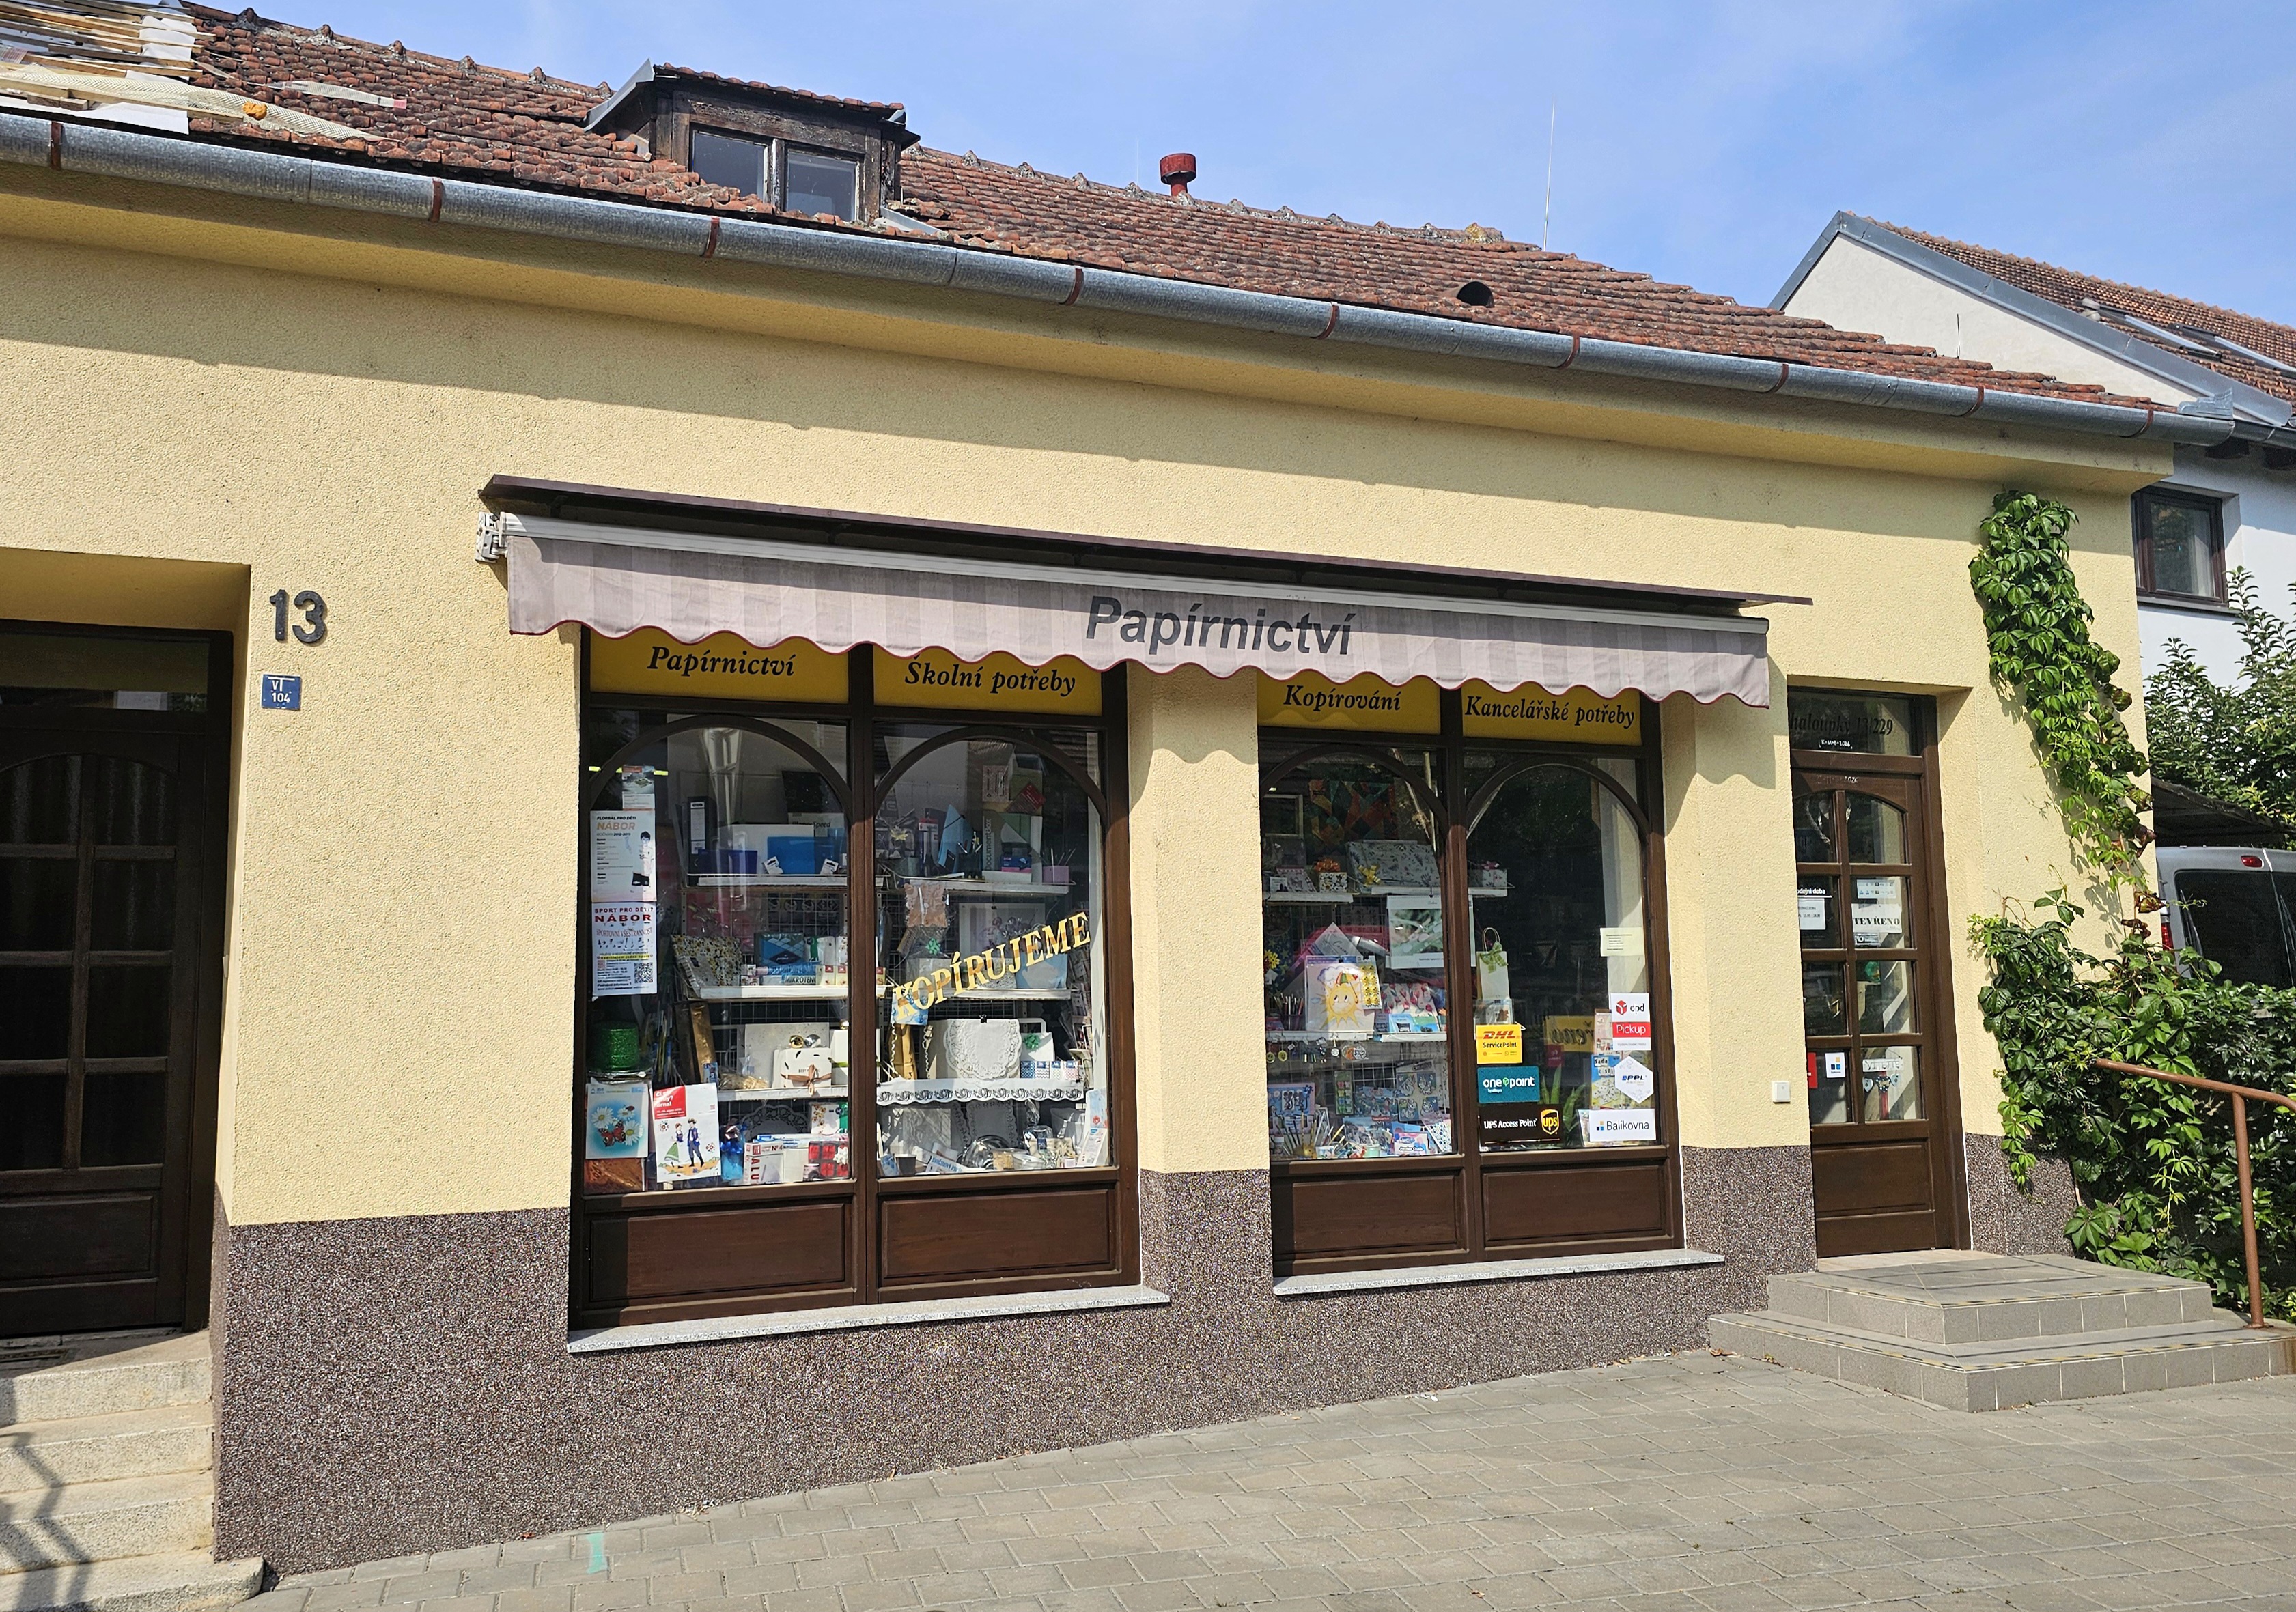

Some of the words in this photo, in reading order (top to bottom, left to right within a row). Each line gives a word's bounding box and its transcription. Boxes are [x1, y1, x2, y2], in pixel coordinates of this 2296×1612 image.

[270, 589, 326, 643] 13
[1086, 596, 1356, 655] Papírnictví
[647, 646, 796, 677] Papírnictví
[905, 655, 984, 688] Školní
[990, 666, 1076, 697] potřeby
[272, 692, 291, 703] 104
[1283, 685, 1402, 712] Kopírování
[1464, 695, 1569, 721] Kancelářské
[1574, 704, 1635, 730] potřeby
[597, 821, 636, 830] NÁBOR
[595, 914, 652, 922] NÁBOR
[893, 912, 1091, 1020] KOPÍRUJEME
[1629, 1003, 1645, 1014] dpd
[1483, 1030, 1516, 1039] DHL
[1616, 1024, 1647, 1035] Pickup
[1483, 1079, 1502, 1088] one
[1509, 1076, 1535, 1088] point
[1483, 1120, 1498, 1129] UPS
[1498, 1120, 1519, 1128] Access
[1606, 1120, 1649, 1131] Balíkovna
[751, 1158, 761, 1180] ALU
